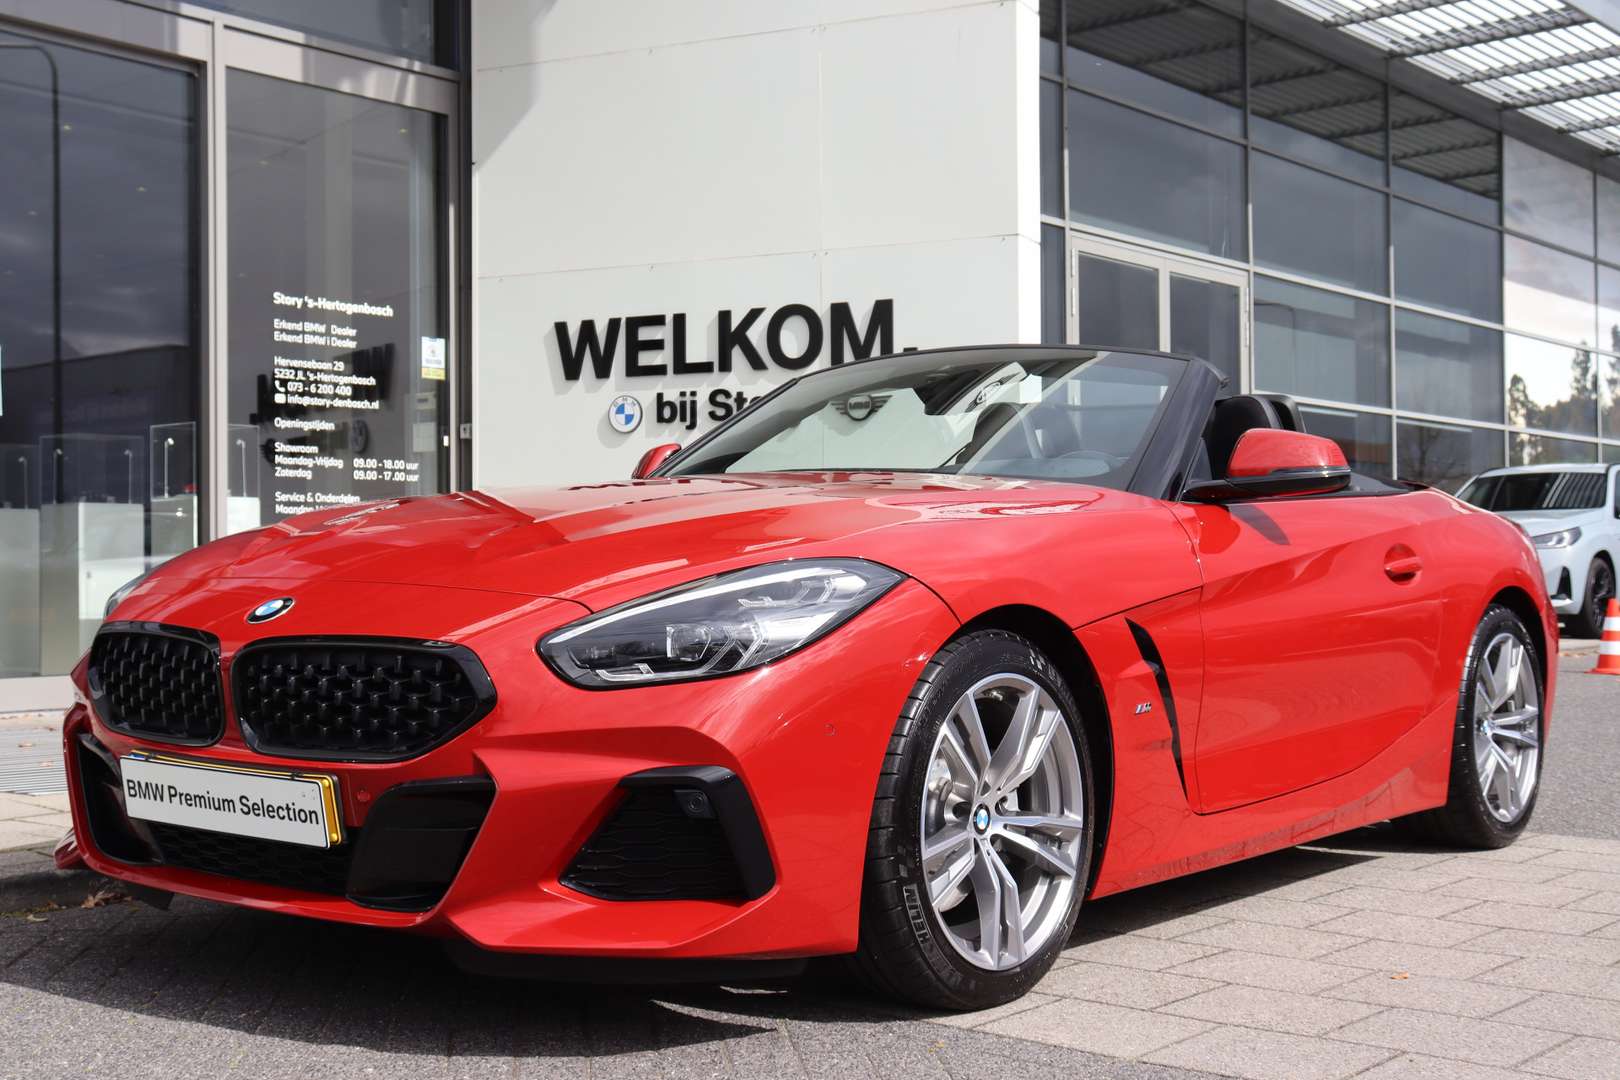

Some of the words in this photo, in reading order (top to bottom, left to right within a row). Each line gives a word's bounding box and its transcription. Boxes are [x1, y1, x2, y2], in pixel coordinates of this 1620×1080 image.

[273, 292, 303, 309] Story
[305, 296, 394, 317] 's-Hertogenbosch
[273, 318, 303, 331] Erkend
[304, 321, 326, 333] BMW
[331, 324, 357, 337] Dealer
[273, 331, 303, 343] Erkend
[304, 334, 326, 345] BMW
[326, 336, 330, 345] i
[331, 337, 357, 348] Dealer
[274, 355, 333, 370] Hervensebaan
[333, 361, 345, 371] 29
[274, 368, 296, 379] 5232
[296, 370, 306, 380] JL
[287, 381, 303, 392] 073
[310, 383, 316, 393] 6
[317, 384, 334, 394] 200
[335, 385, 352, 396] 400
[287, 394, 379, 409] info@story-denbosch.nl
[656, 391, 697, 430] bij
[708, 388, 763, 422] St
[274, 417, 335, 431] Openingstijden
[274, 442, 319, 453] Showroom
[274, 455, 344, 469] Maandag-Vrijdag
[353, 458, 377, 468] 09.00
[383, 459, 405, 470] 18.00
[406, 462, 419, 470] uur
[274, 467, 312, 479] Zaterdag
[353, 470, 377, 480] 09.00
[406, 474, 419, 482] uur
[274, 491, 305, 502] Service
[306, 492, 314, 503] &
[315, 492, 360, 504] Onderdelen
[126, 779, 164, 802] BMW
[168, 785, 236, 813] Premium
[239, 795, 319, 825] Selection
